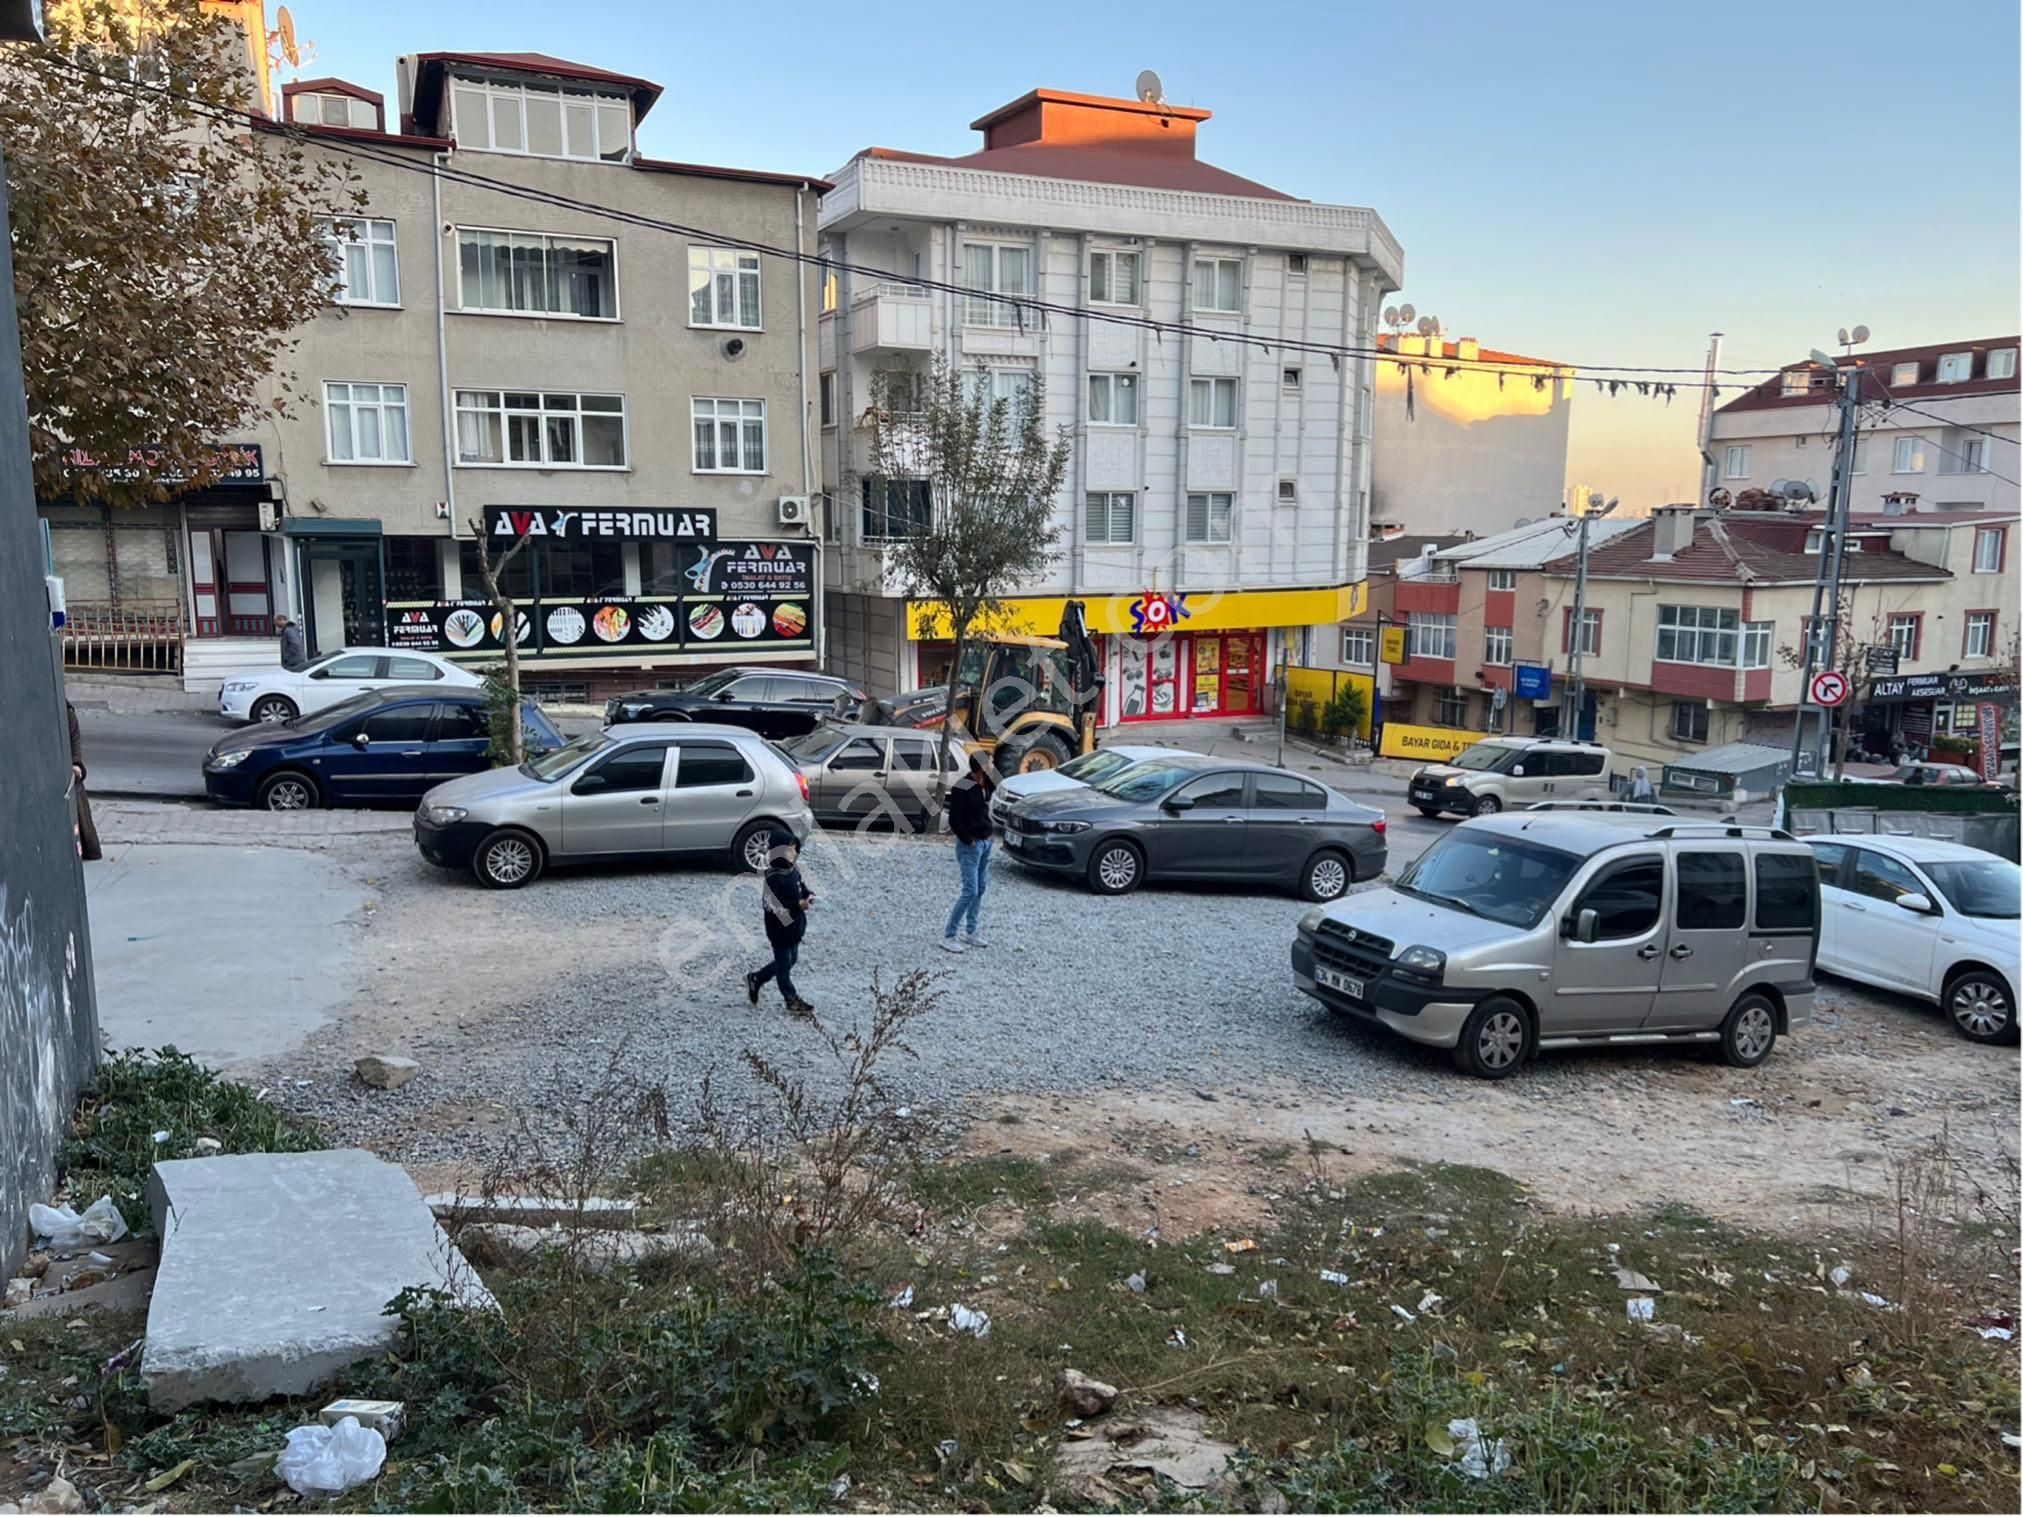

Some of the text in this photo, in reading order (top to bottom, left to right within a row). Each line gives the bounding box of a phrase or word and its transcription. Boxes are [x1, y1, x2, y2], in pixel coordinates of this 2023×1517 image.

[245, 469, 260, 477] 95
[494, 511, 710, 537] AVA FERMUAR
[744, 544, 793, 559] AVA
[727, 561, 806, 573] FERMUAR
[731, 581, 806, 589] 0530 644 92 56
[401, 611, 430, 623] AVA
[1129, 590, 1191, 639] ŞOK
[393, 625, 439, 634] FERMUAR
[1907, 676, 1939, 685] FERMUAR
[1873, 682, 1946, 697] ALTAY AKSESUAR
[1401, 735, 1431, 748] BAYAR
[1431, 739, 1451, 750] GIDA
[1452, 740, 1460, 751] &
